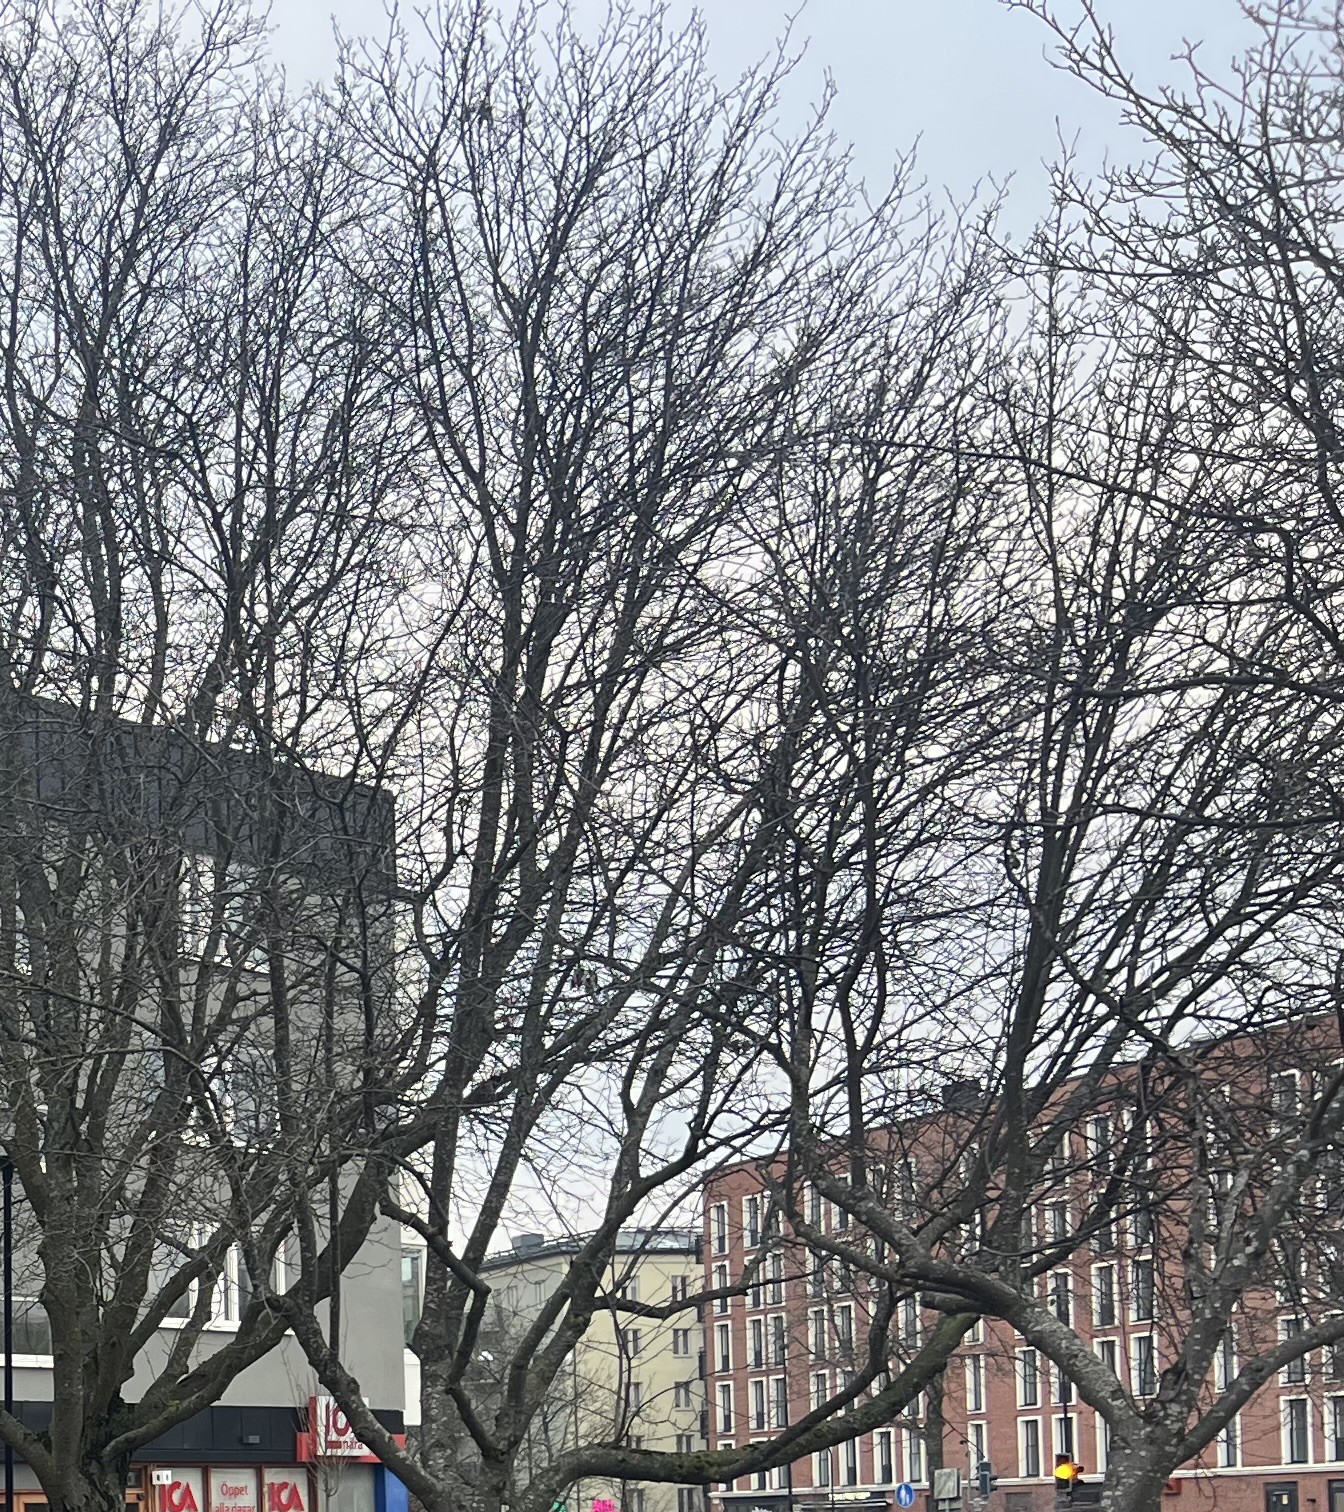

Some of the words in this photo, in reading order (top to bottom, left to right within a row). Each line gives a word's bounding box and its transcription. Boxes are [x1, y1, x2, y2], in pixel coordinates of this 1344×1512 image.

[159, 1481, 199, 1512] ICA
[220, 1481, 248, 1500] Öppet
[268, 1481, 305, 1512] ICA
